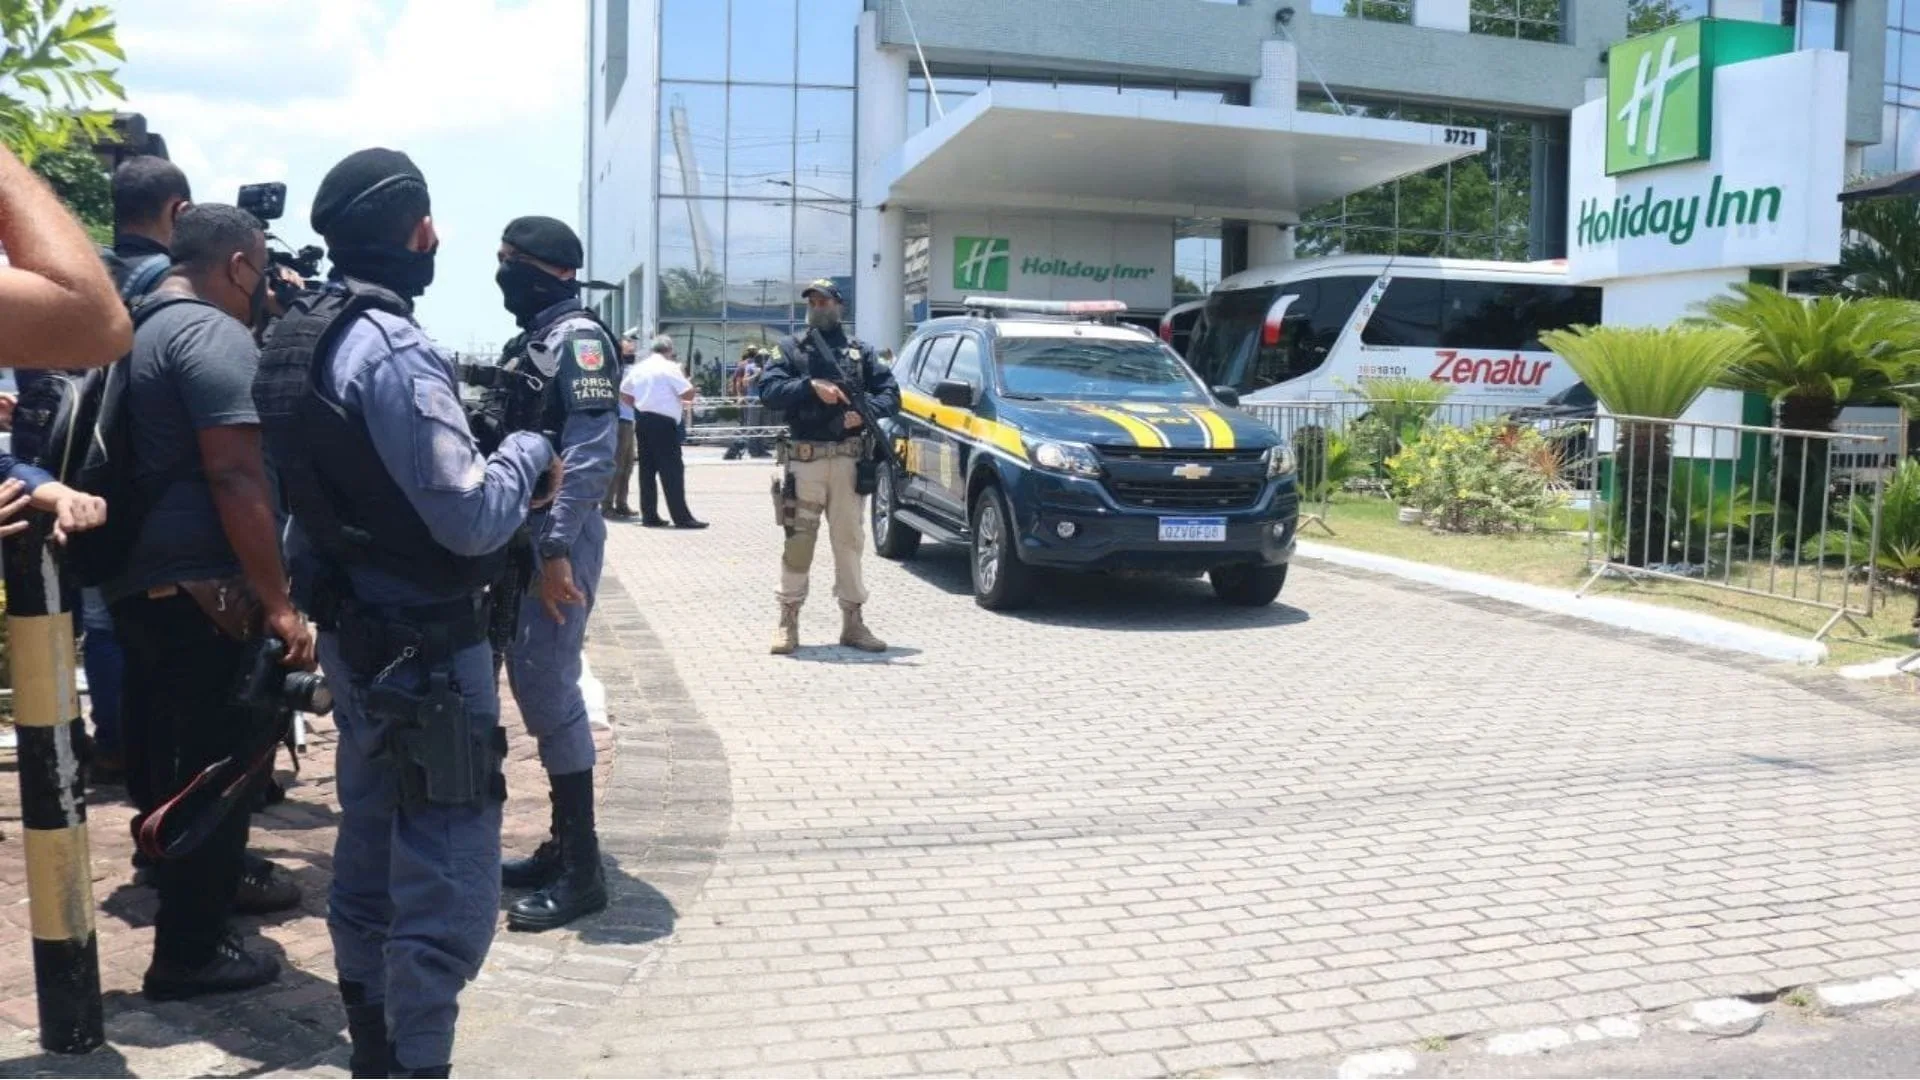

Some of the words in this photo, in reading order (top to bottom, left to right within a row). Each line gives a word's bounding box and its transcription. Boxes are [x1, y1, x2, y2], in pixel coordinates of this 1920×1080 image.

[1444, 128, 1476, 145] 3721
[1577, 187, 1700, 246] Holiday
[1705, 175, 1783, 227] Inn
[1021, 257, 1110, 282] Holiday
[1112, 264, 1149, 279] Inn
[1429, 350, 1551, 386] Zenatur
[574, 387, 615, 399] TÁTICA
